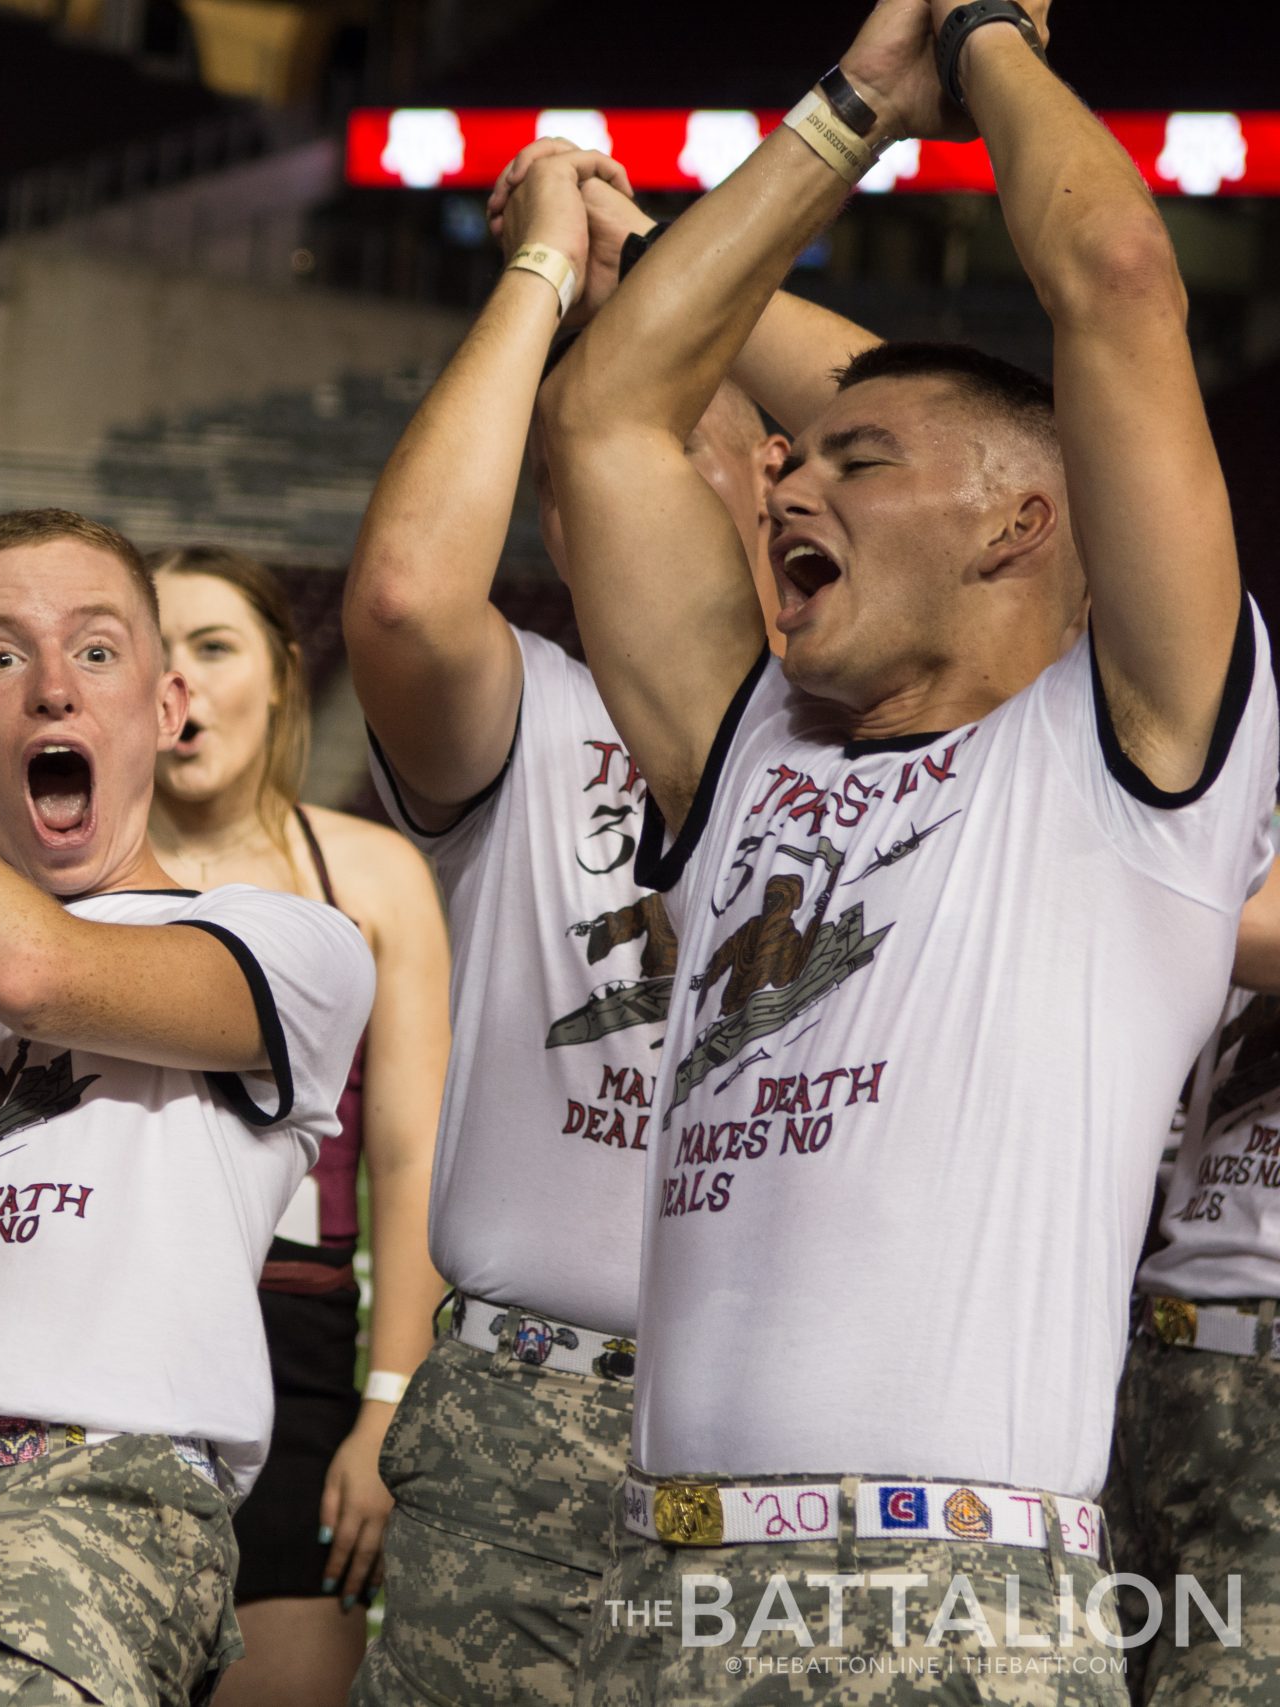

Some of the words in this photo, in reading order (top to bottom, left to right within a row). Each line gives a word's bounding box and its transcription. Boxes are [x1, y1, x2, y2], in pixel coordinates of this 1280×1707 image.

[823, 129, 850, 154] ACCESS
[751, 1060, 888, 1118] DEATH
[674, 1119, 773, 1168] MAKES
[779, 1113, 833, 1156] NO
[743, 1492, 829, 1536] '20
